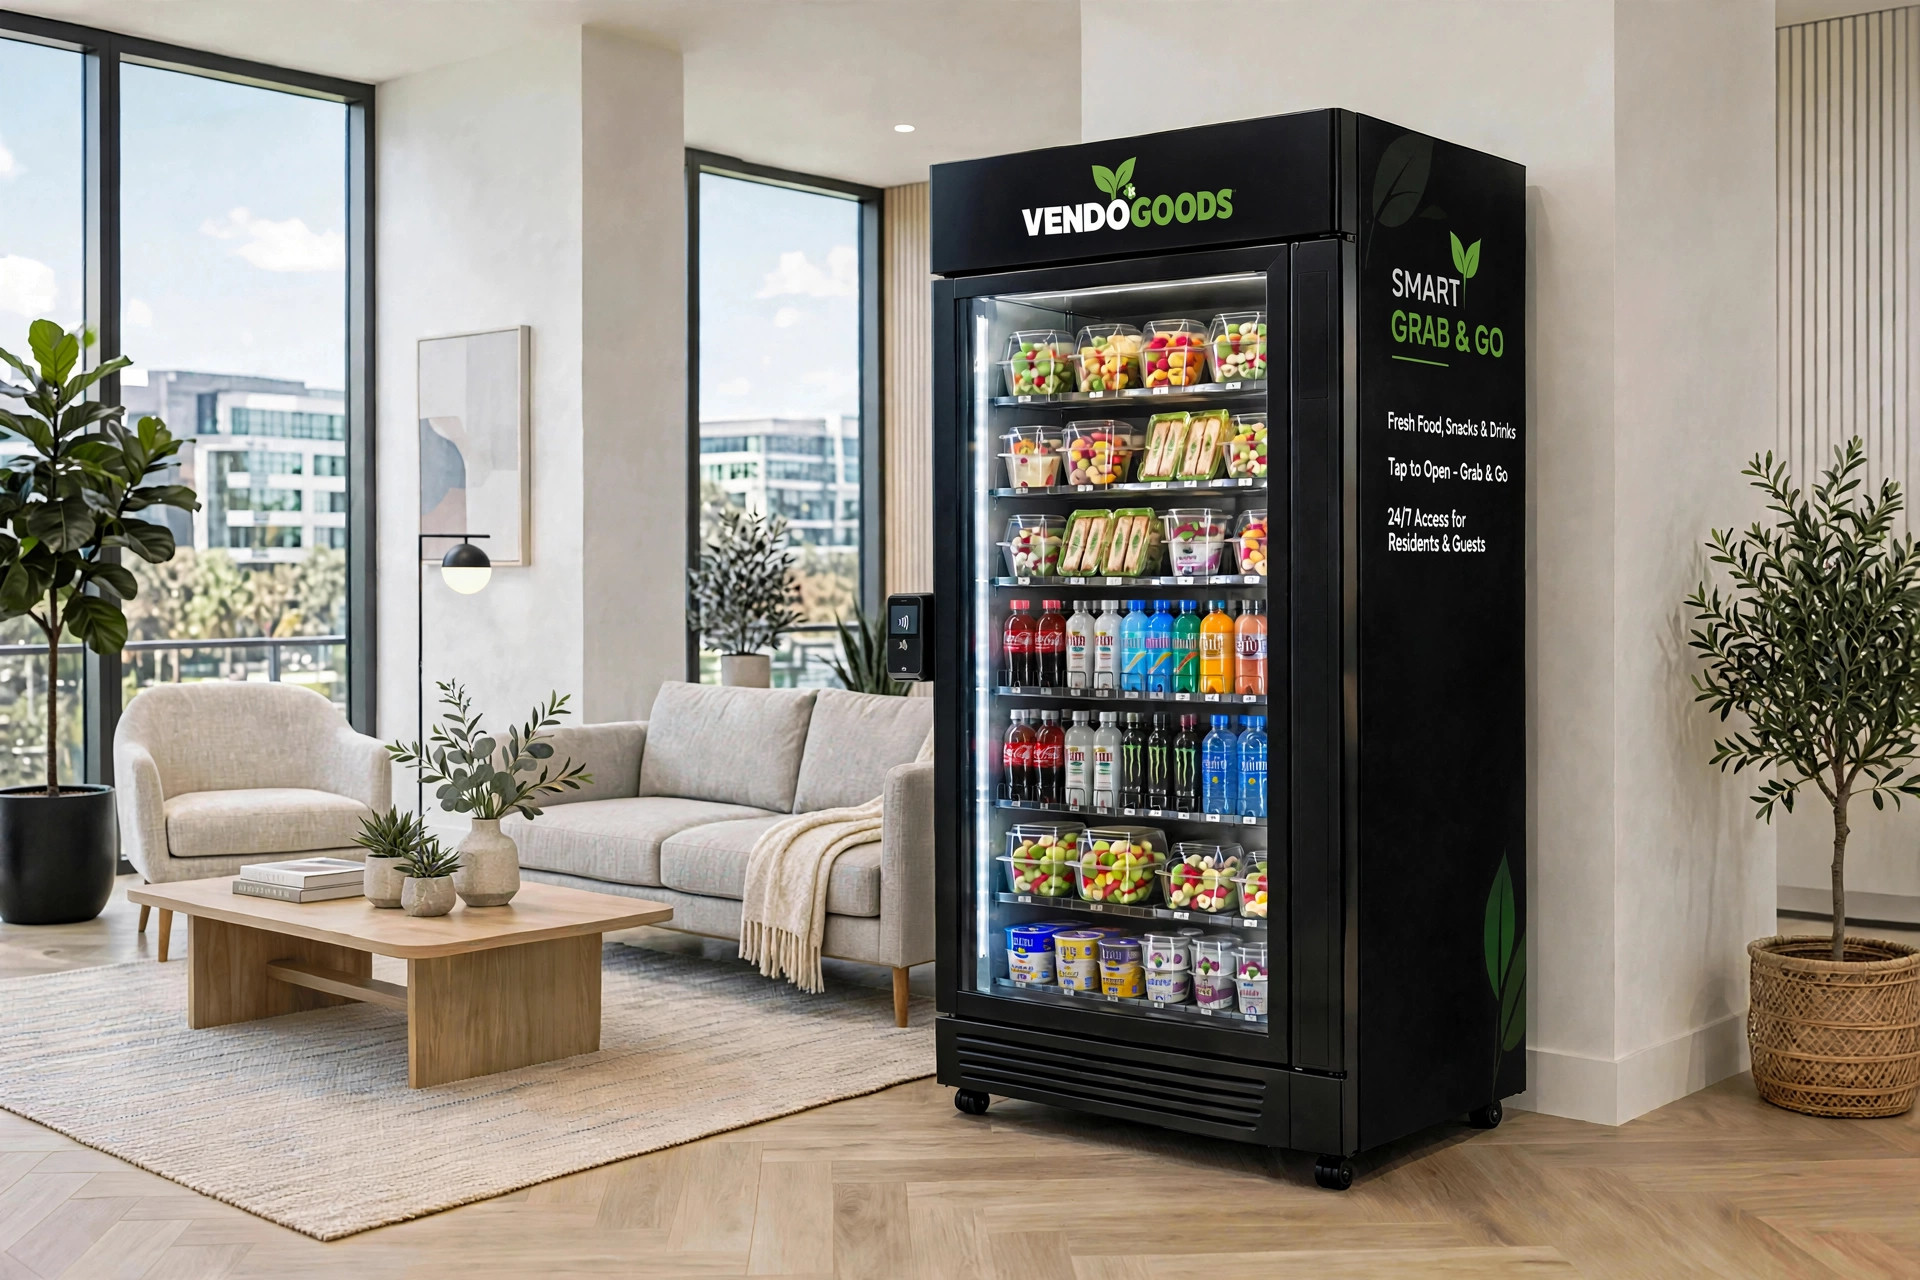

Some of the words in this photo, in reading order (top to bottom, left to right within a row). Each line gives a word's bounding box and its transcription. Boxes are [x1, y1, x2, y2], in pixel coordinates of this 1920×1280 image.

[1391, 267, 1461, 307] SMART
[1391, 309, 1450, 348] GRAB
[1455, 320, 1471, 353] &
[1474, 324, 1504, 358] GO
[1387, 411, 1416, 432] Fresh
[1417, 414, 1445, 438] Food,
[1445, 417, 1479, 437] Snacks
[1480, 420, 1488, 438] &
[1489, 420, 1517, 440] Drinks
[1387, 456, 1408, 482] Tap
[1409, 459, 1422, 478] to
[1423, 459, 1451, 484] Open
[1459, 462, 1484, 482] Grab
[1485, 463, 1494, 482] &
[1494, 464, 1509, 483] Go
[1387, 505, 1413, 529] 24/7
[1413, 507, 1450, 528] Access
[1451, 508, 1467, 528] for
[1388, 531, 1440, 553] Residents
[1441, 533, 1451, 553] &
[1451, 534, 1486, 553] Guests
